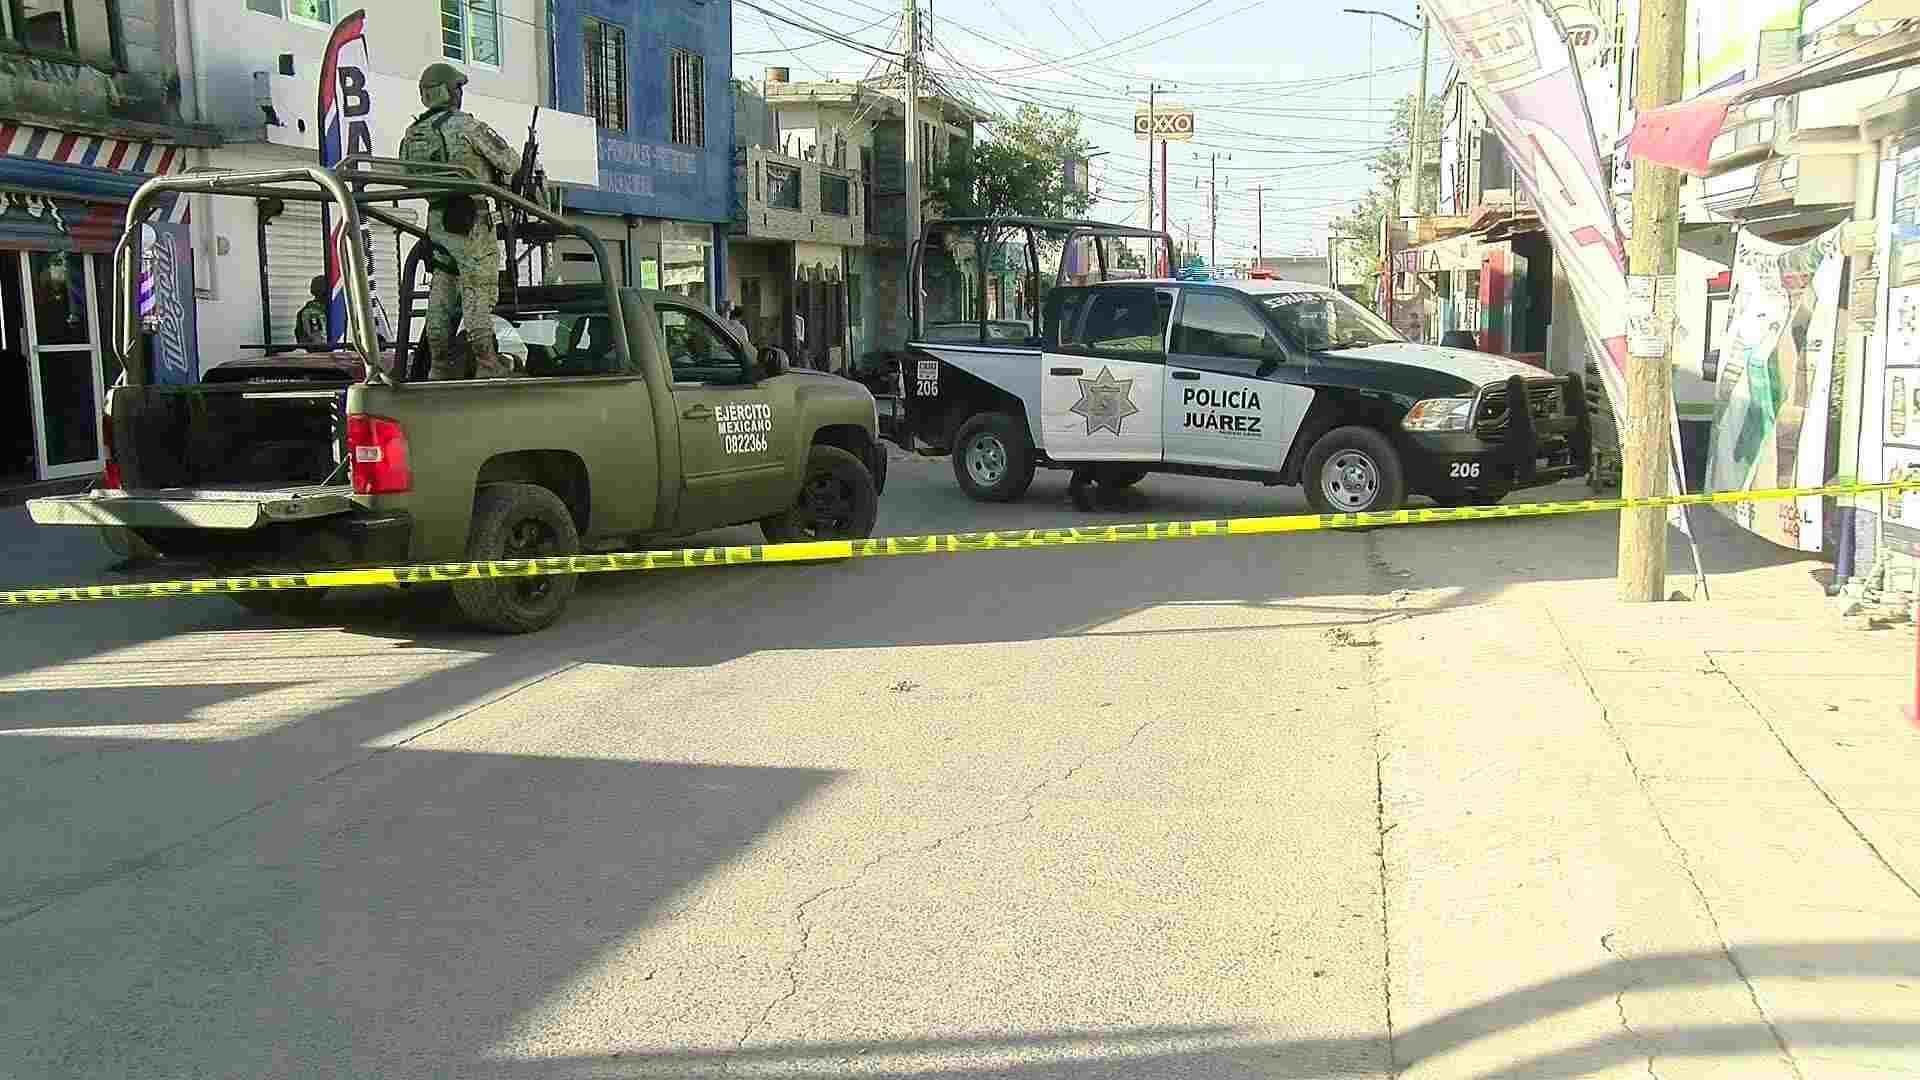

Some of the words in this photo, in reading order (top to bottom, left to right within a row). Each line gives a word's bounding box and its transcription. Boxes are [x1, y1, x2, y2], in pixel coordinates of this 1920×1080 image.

[1136, 115, 1192, 132] OXXO
[916, 380, 938, 397] 206
[1183, 387, 1261, 410] POLICÍA
[714, 401, 771, 421] EJÉRCITO
[718, 419, 772, 434] MEXICANO
[1183, 409, 1261, 432] JUÁREZ
[725, 432, 768, 454] 0822366
[1450, 462, 1480, 478] 206
